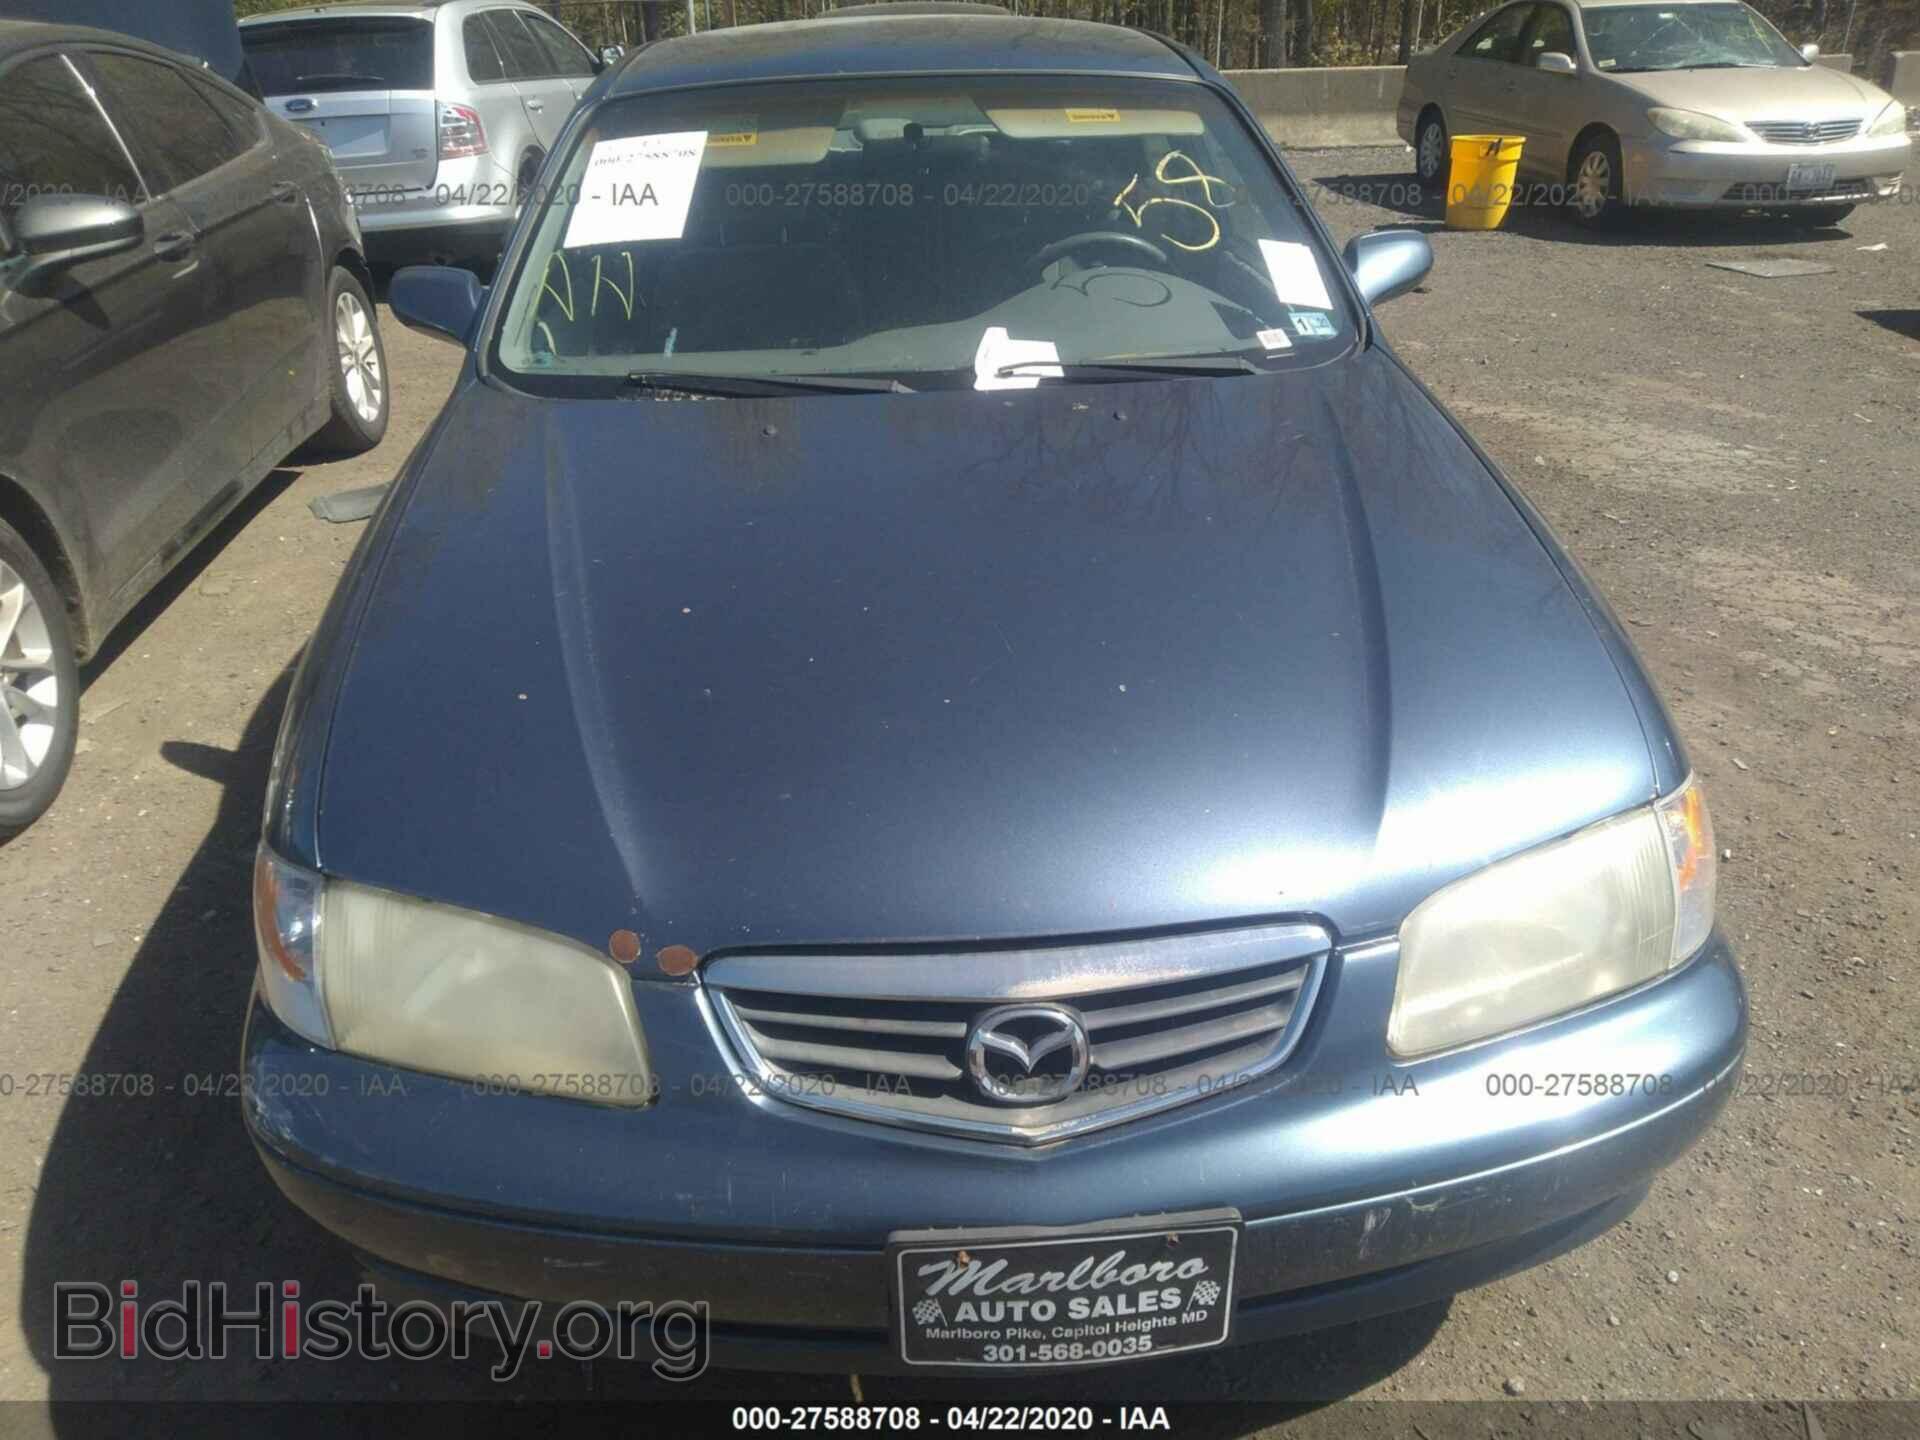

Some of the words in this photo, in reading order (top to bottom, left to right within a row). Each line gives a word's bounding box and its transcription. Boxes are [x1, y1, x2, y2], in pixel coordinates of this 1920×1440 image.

[917, 1250, 1209, 1296] Marlboro
[954, 1299, 1057, 1323] AUTO
[1067, 1287, 1182, 1320] SALES
[926, 1327, 1001, 1339] Marlboro
[1006, 1327, 1047, 1341] Pike,
[1051, 1323, 1110, 1339] Capitol
[1114, 1315, 1178, 1335] Heights
[1181, 1309, 1208, 1325] MD
[983, 1335, 1153, 1362] 301-568-0035
